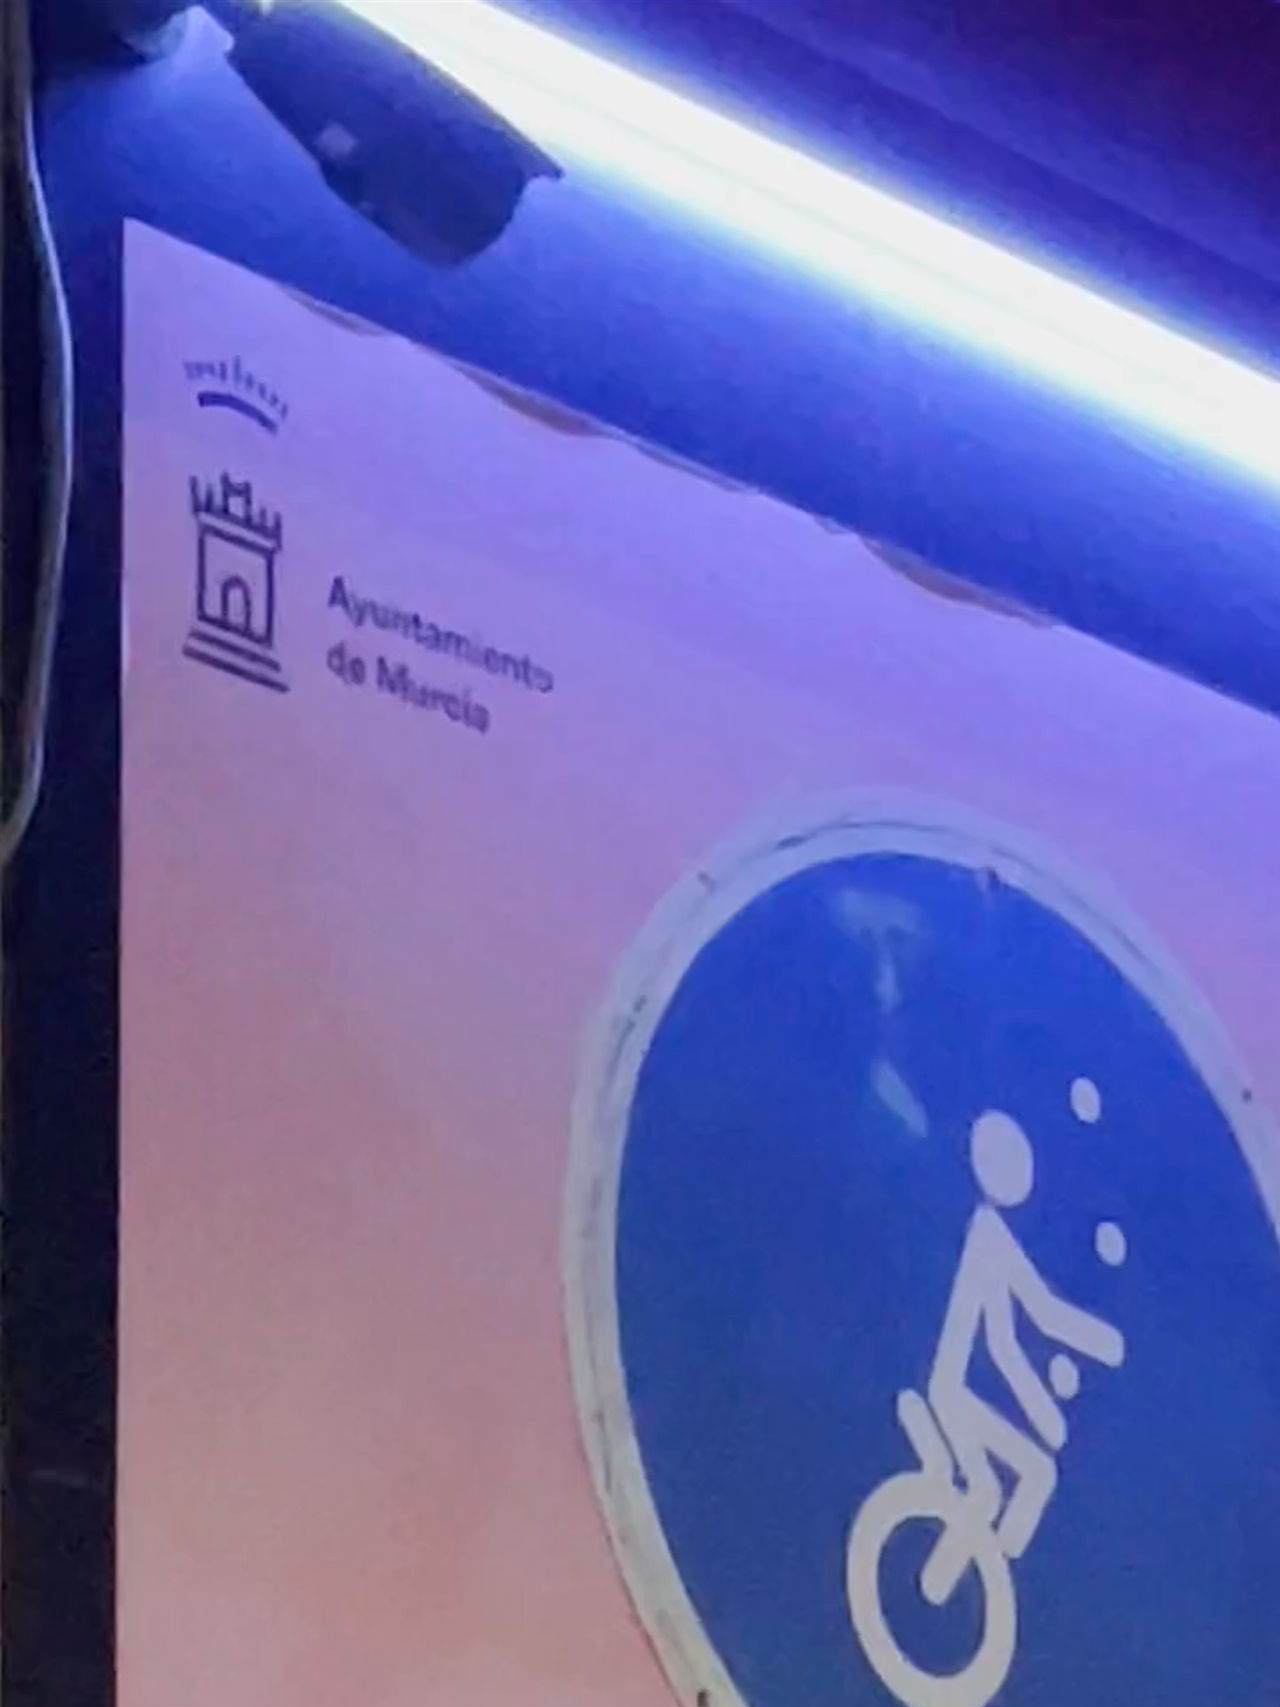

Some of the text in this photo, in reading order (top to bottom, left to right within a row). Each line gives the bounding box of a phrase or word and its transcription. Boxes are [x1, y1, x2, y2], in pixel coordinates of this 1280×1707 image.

[328, 576, 554, 693] Ayuntamiento
[327, 642, 491, 734] de Murcia
